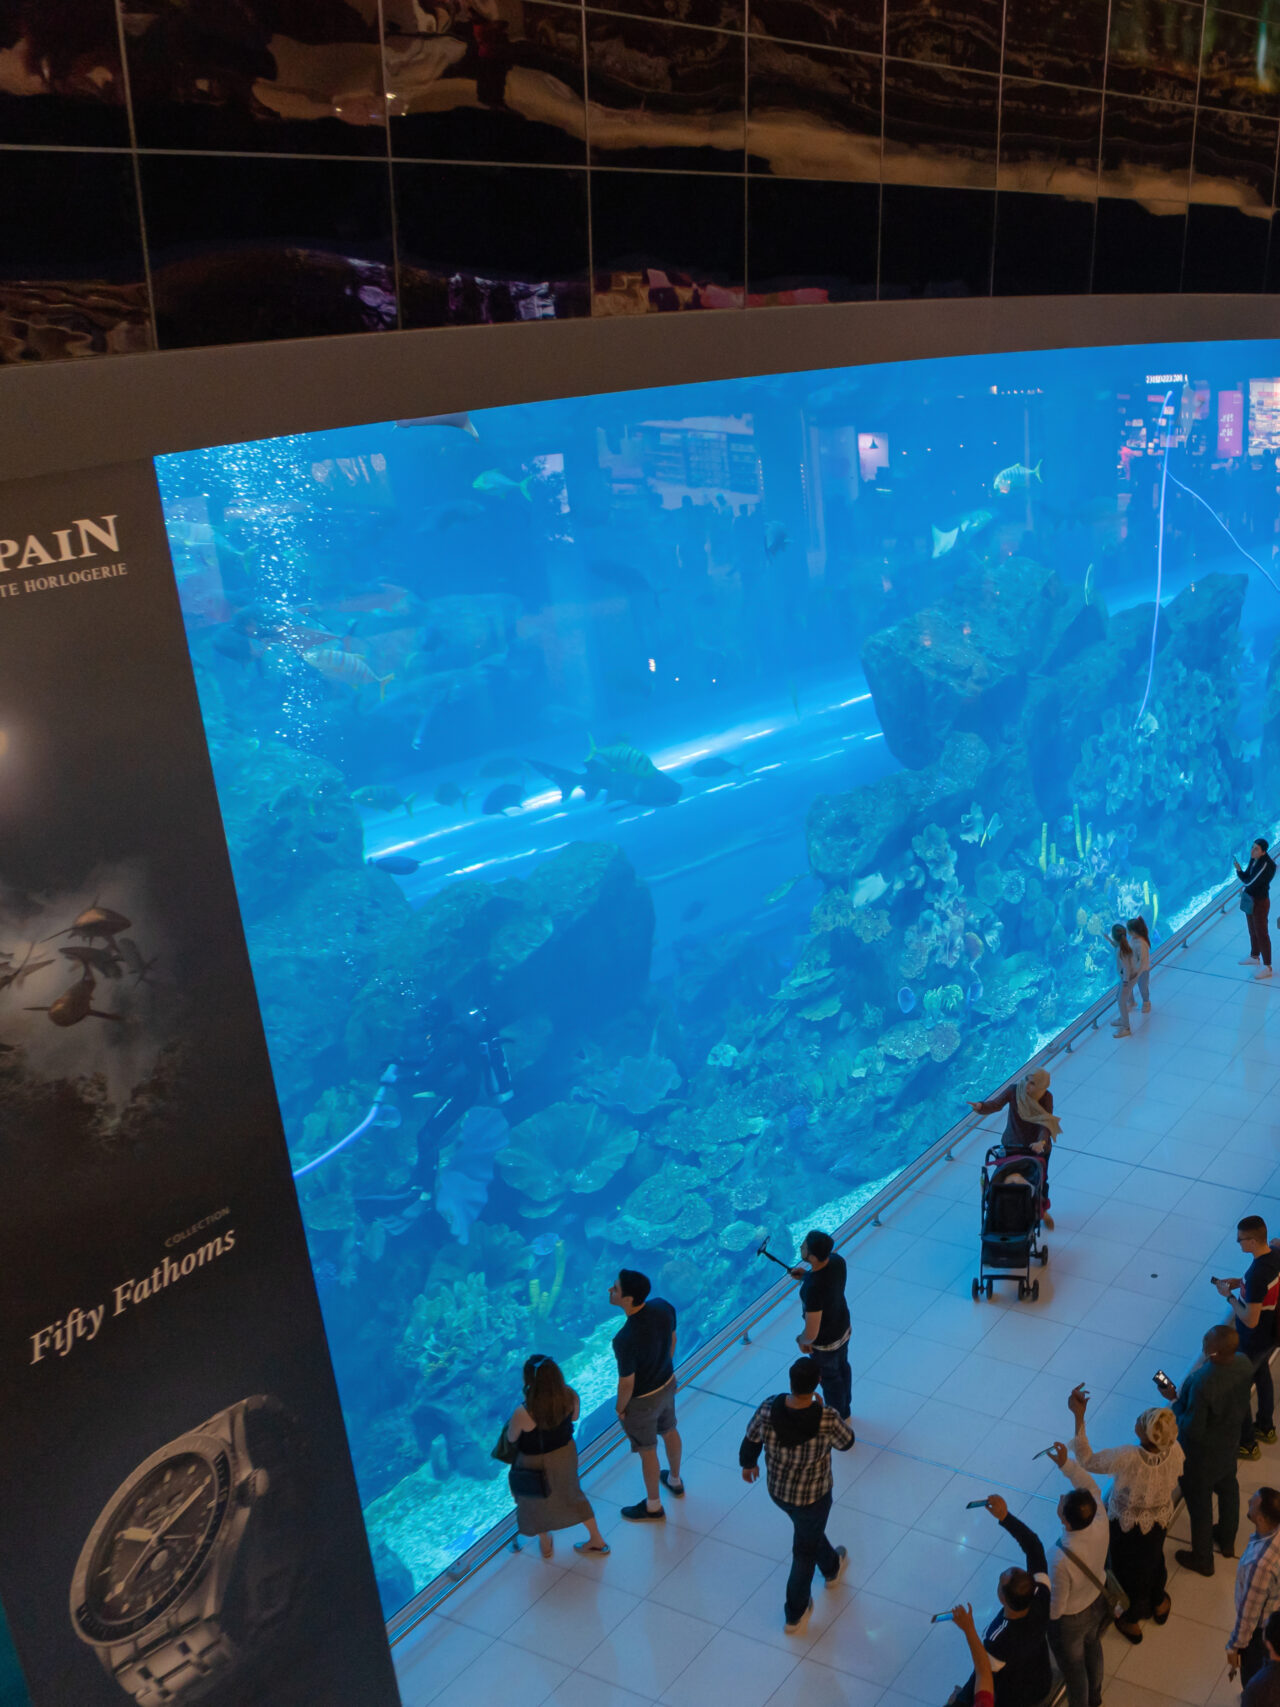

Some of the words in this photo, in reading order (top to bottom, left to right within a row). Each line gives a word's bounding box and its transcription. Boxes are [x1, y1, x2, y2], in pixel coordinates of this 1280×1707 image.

[0, 514, 120, 573] PAIN
[24, 563, 128, 593] HORLOGERIE
[164, 1206, 231, 1248] COLLECTION
[30, 1304, 105, 1366] Fifty
[112, 1229, 237, 1318] Fathoms
